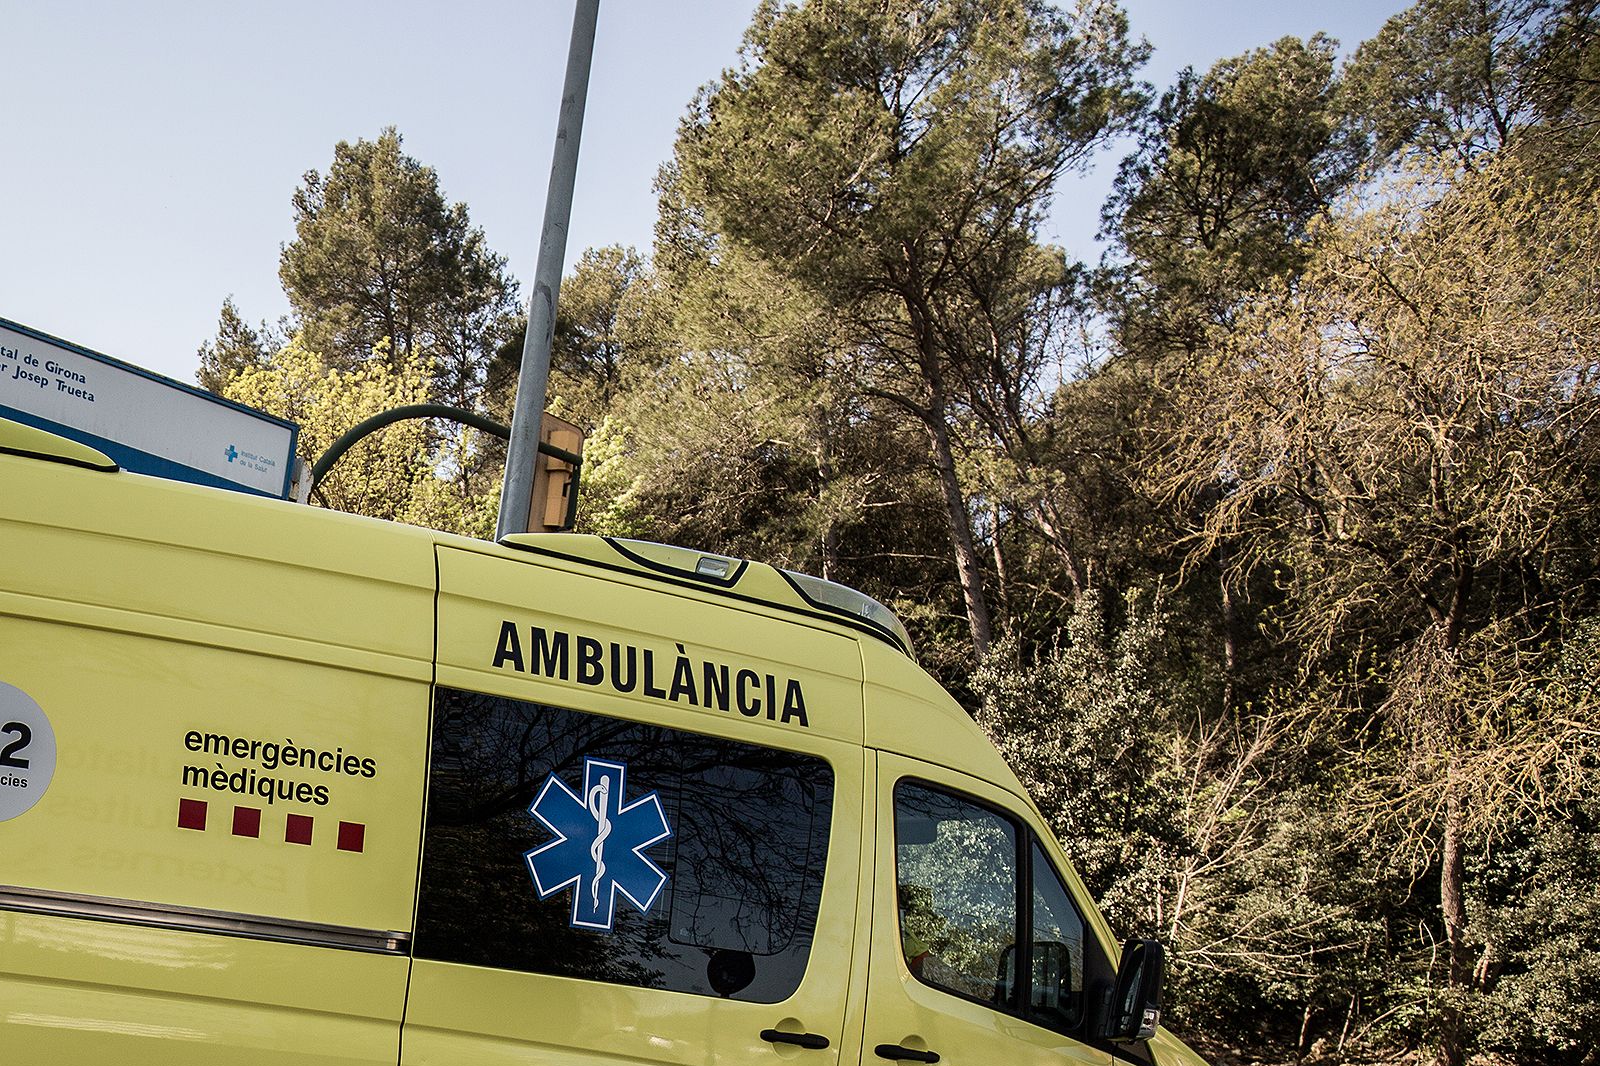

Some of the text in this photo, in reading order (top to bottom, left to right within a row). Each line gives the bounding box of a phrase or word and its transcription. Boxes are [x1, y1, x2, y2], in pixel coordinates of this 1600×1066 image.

[12, 366, 49, 389] Josep
[56, 378, 95, 402] Trueta
[24, 353, 40, 369] de
[45, 360, 87, 385] Girona
[491, 620, 810, 728] AMBULÀNCIA
[184, 729, 377, 779] emergències
[181, 761, 330, 806] mèdiques
